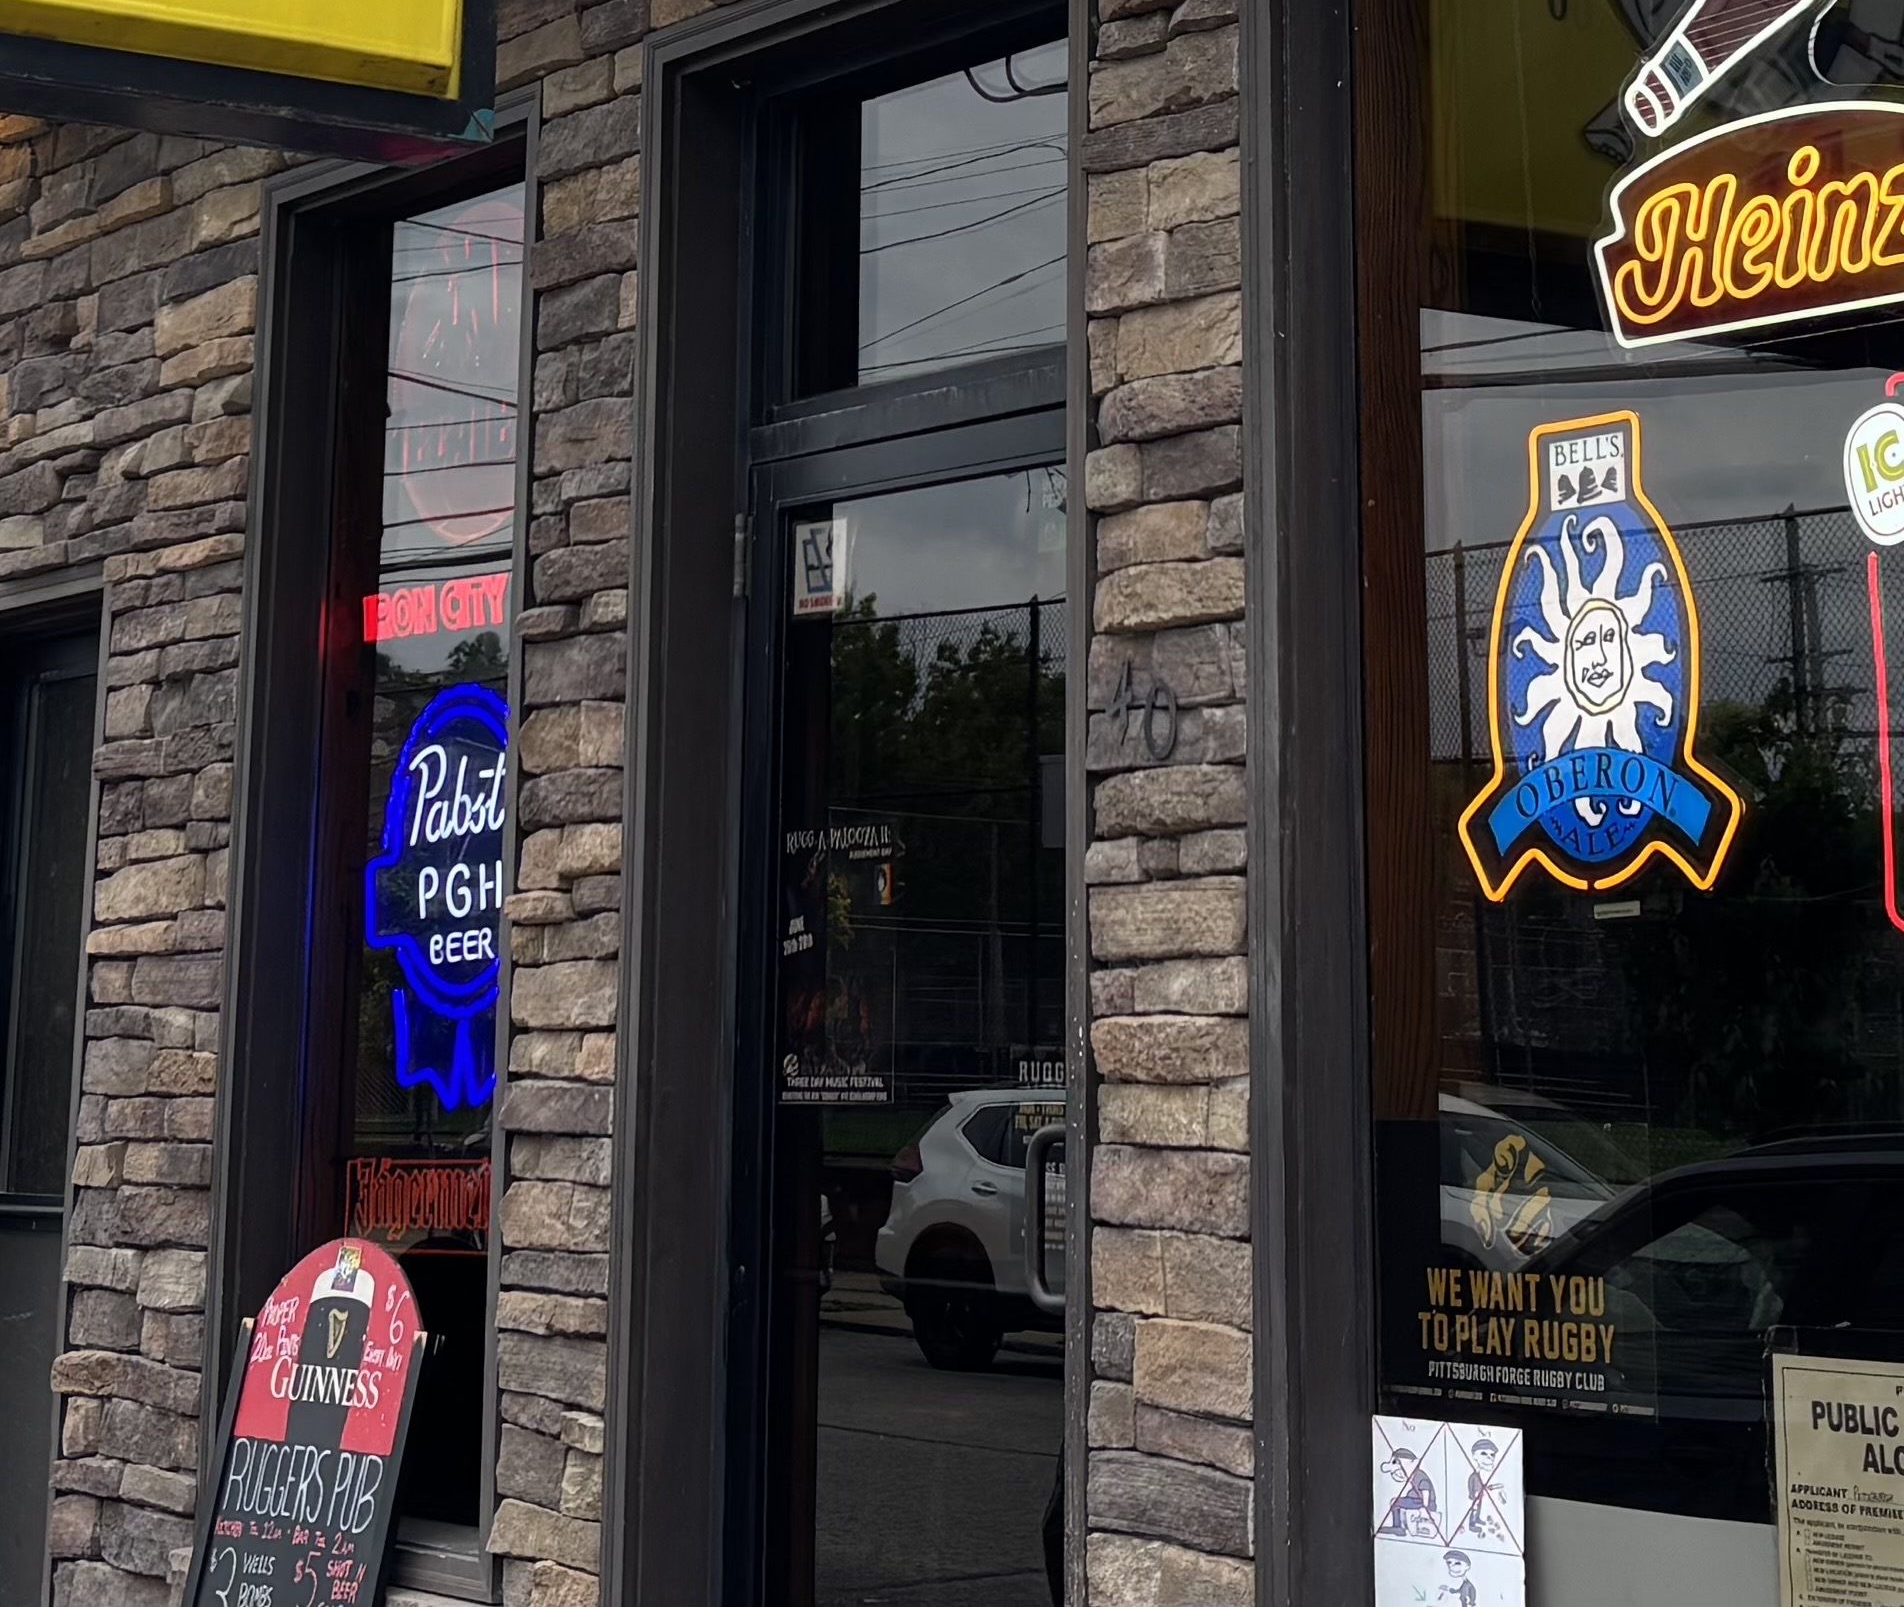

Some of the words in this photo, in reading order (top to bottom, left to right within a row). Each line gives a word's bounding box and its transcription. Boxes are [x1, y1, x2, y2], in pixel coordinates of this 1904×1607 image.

[1554, 435, 1619, 466] BELL'S
[440, 572, 509, 631] CITY
[1104, 659, 1177, 761] 40
[409, 744, 506, 846] Pabst
[1516, 753, 1678, 819] OBERON
[1562, 822, 1624, 856] ALE
[418, 859, 503, 919] PGH
[429, 927, 495, 965] BEER
[1427, 1267, 1462, 1307] WE
[1468, 1269, 1540, 1313] WANT
[1550, 1274, 1605, 1317] YOU
[1418, 1311, 1447, 1351] TO
[1456, 1314, 1515, 1356] PLAY
[1524, 1319, 1615, 1364] RUGBY
[271, 1356, 382, 1409] GUINNESS
[1428, 1360, 1494, 1383] PITTSBURGH
[1496, 1365, 1531, 1386] FORGE
[1533, 1368, 1573, 1390] RUGBY
[1575, 1372, 1605, 1392] CLUB
[1812, 1400, 1899, 1437] PUBLIC
[222, 1437, 331, 1524] RUGGERS
[327, 1452, 384, 1534] PUB
[1791, 1483, 1848, 1499] APPLICANT
[1791, 1499, 1839, 1513] ADDRESS
[1842, 1504, 1854, 1515] OF
[243, 1552, 276, 1575] WELLS
